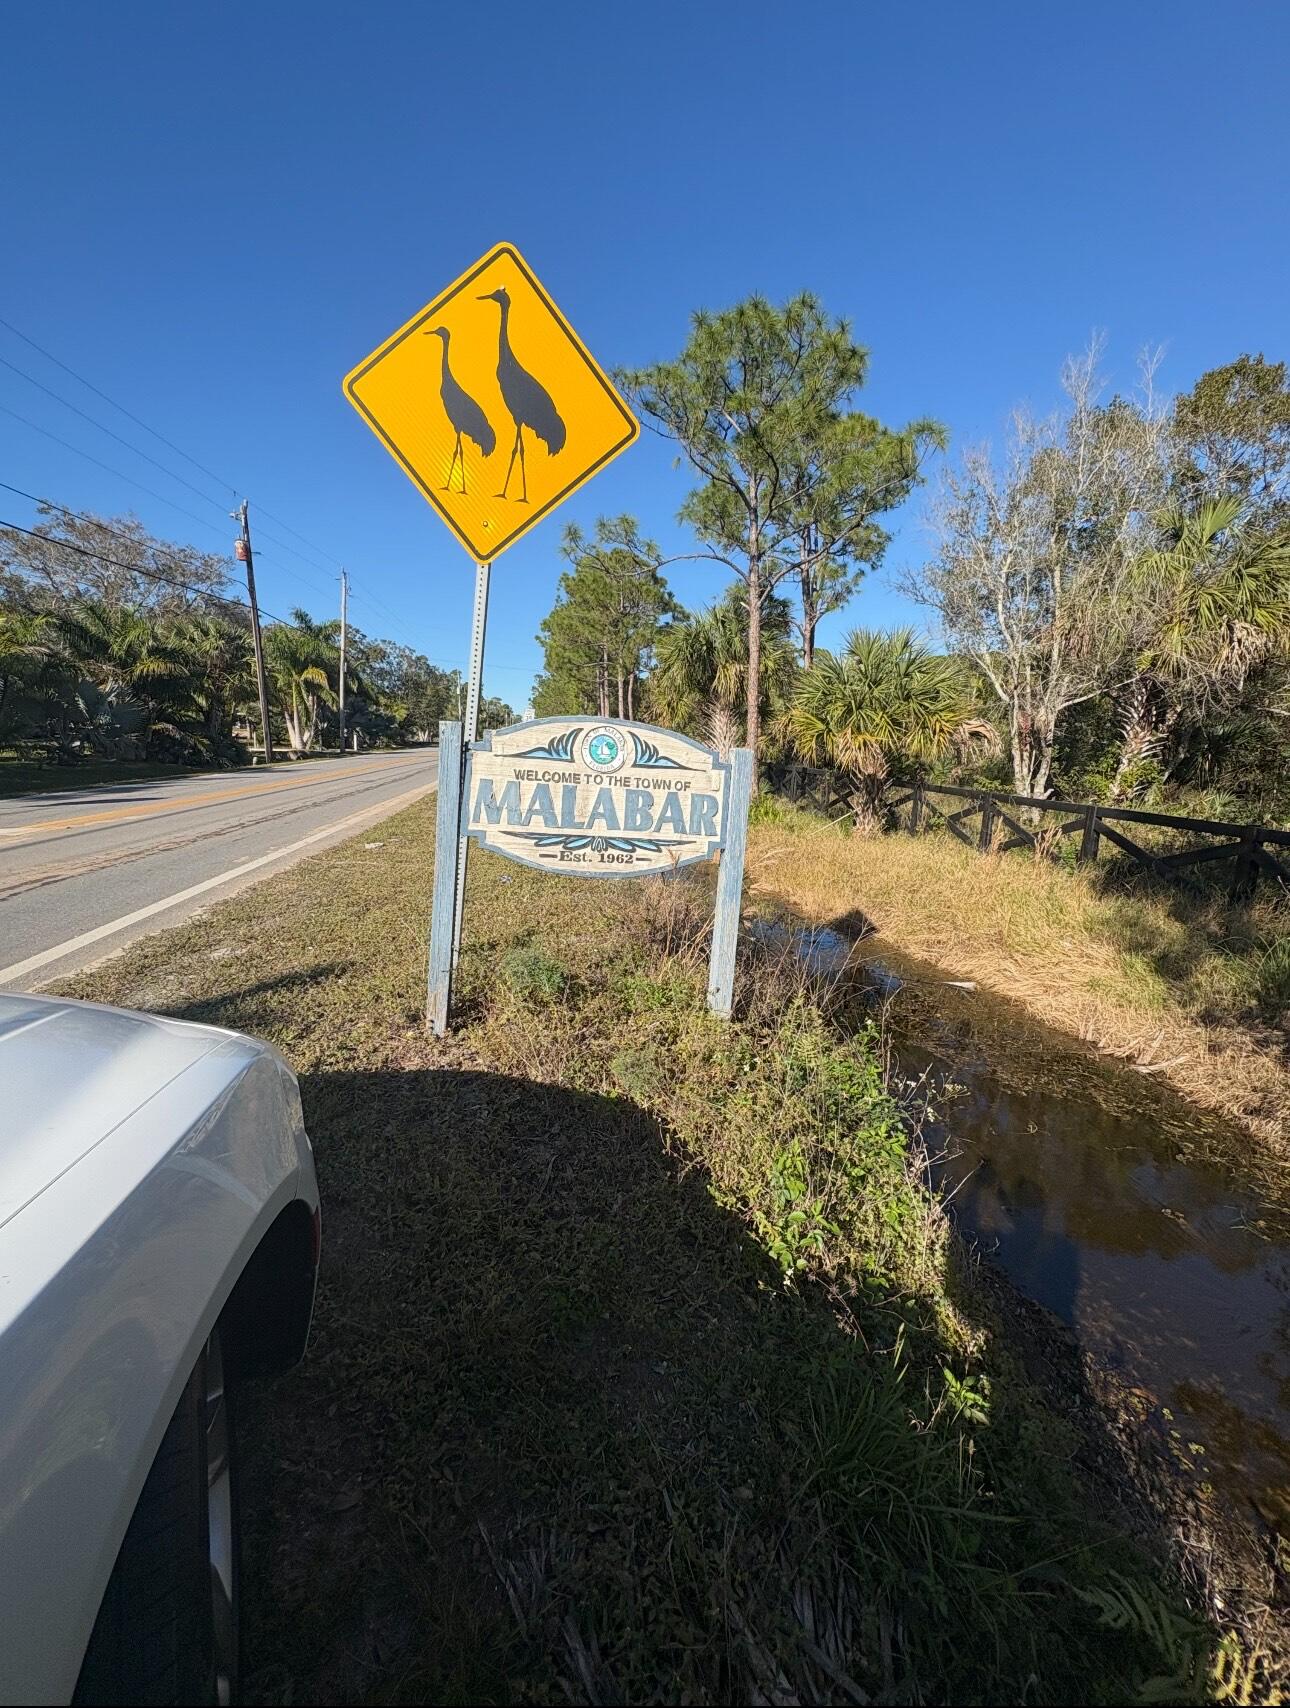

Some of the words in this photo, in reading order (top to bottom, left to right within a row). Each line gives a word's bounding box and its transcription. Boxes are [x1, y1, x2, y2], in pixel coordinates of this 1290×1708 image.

[513, 768, 581, 785] WELCOME
[585, 773, 604, 786] TO
[606, 775, 631, 788] THE
[634, 777, 673, 791] TOWN
[674, 780, 692, 792] OF
[471, 778, 720, 836] MALABAR
[558, 850, 593, 863] Est.
[598, 852, 634, 864] 1962
